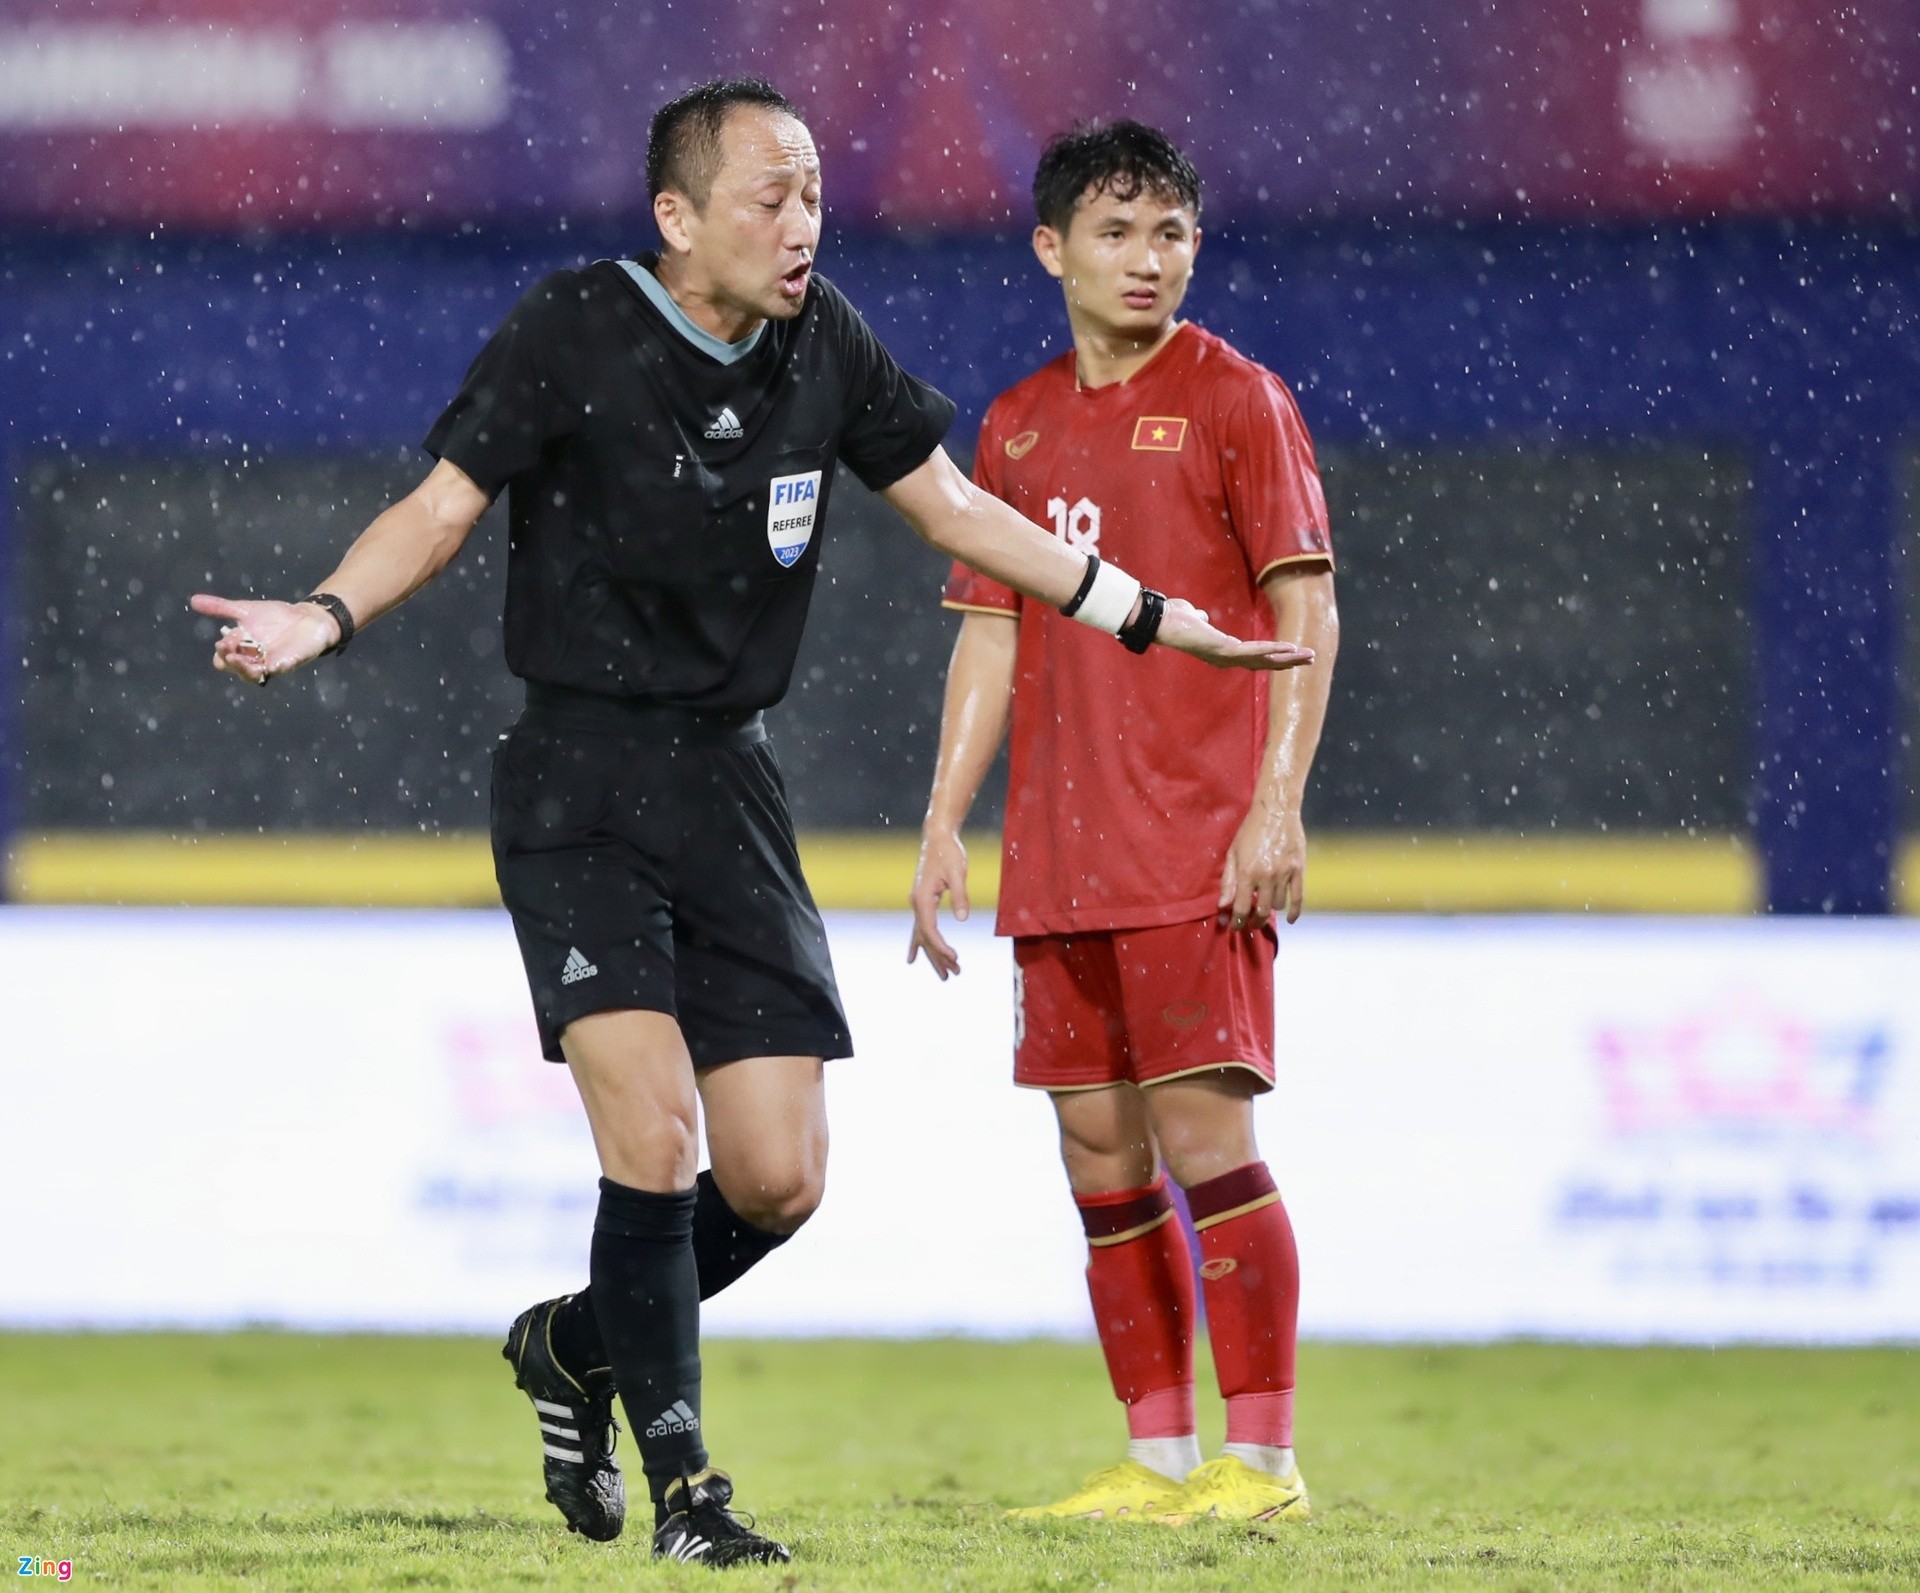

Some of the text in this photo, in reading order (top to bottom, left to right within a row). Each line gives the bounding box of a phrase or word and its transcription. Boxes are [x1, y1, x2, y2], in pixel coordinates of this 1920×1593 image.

[704, 428, 744, 439] adidas
[775, 479, 815, 506] FIFA
[772, 514, 813, 532] REFEREE
[780, 546, 800, 560] 2023
[561, 964, 598, 986] adidas
[646, 1418, 699, 1438] adidas
